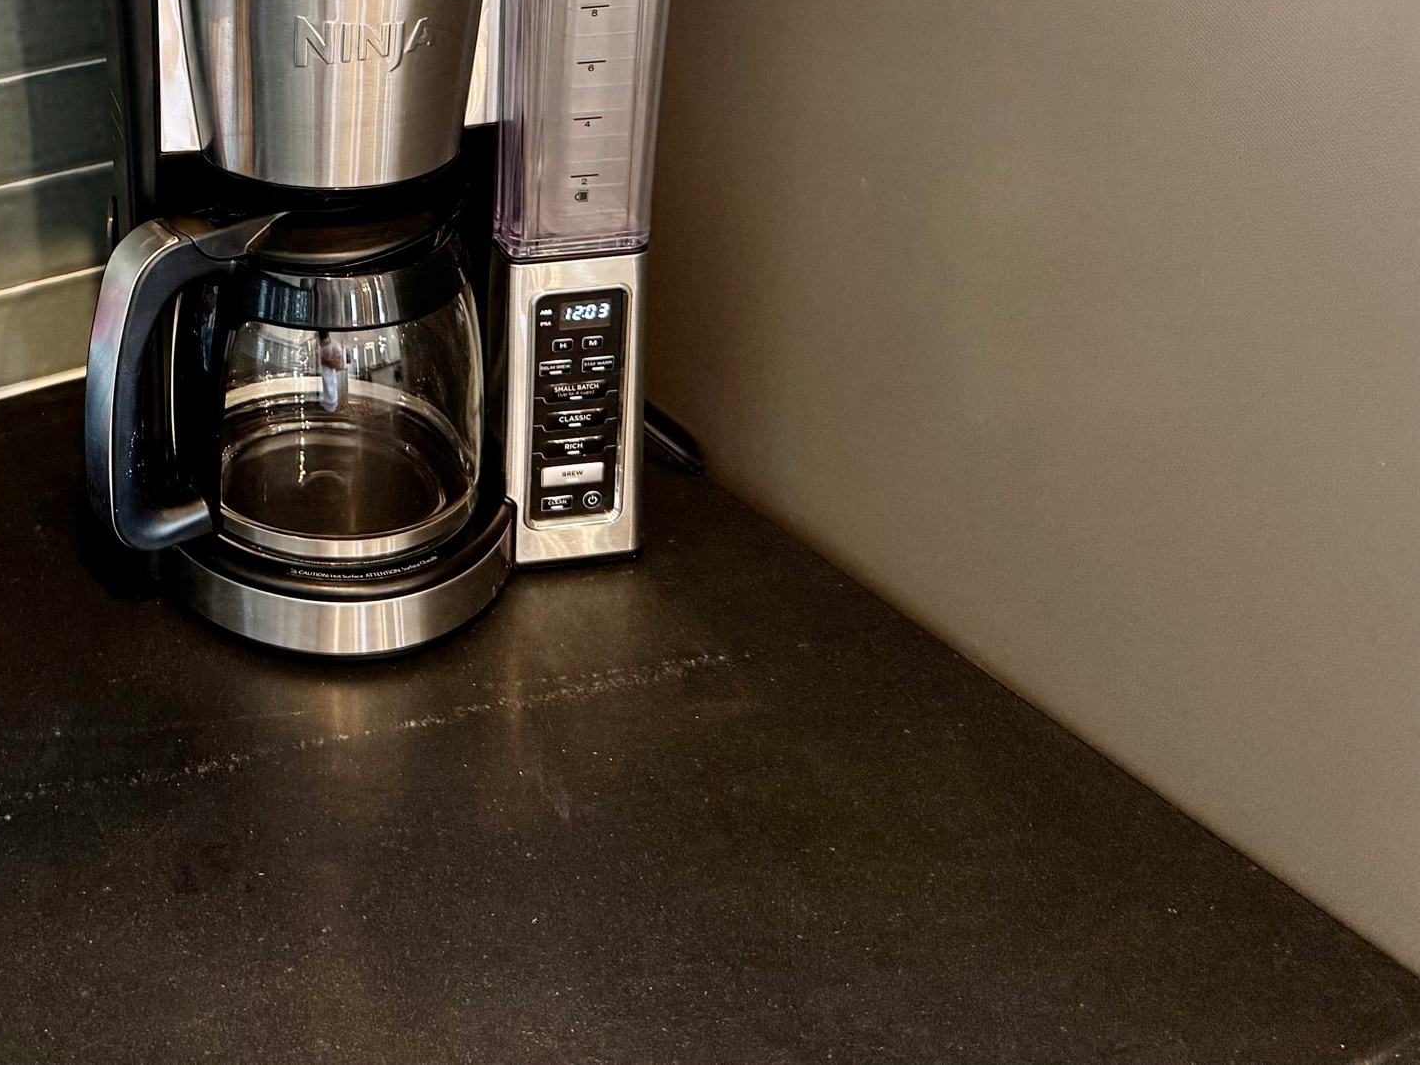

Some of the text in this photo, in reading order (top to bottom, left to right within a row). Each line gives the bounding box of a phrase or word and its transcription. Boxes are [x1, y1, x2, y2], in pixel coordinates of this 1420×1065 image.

[591, 9, 598, 17] 8
[293, 15, 430, 72] NINJA
[587, 64, 595, 72] 6
[565, 302, 610, 321] 12:03
[588, 339, 598, 347] M
[553, 382, 600, 394] SMALL BATCH
[558, 414, 592, 423] CLASSIC
[564, 442, 584, 450] RICH
